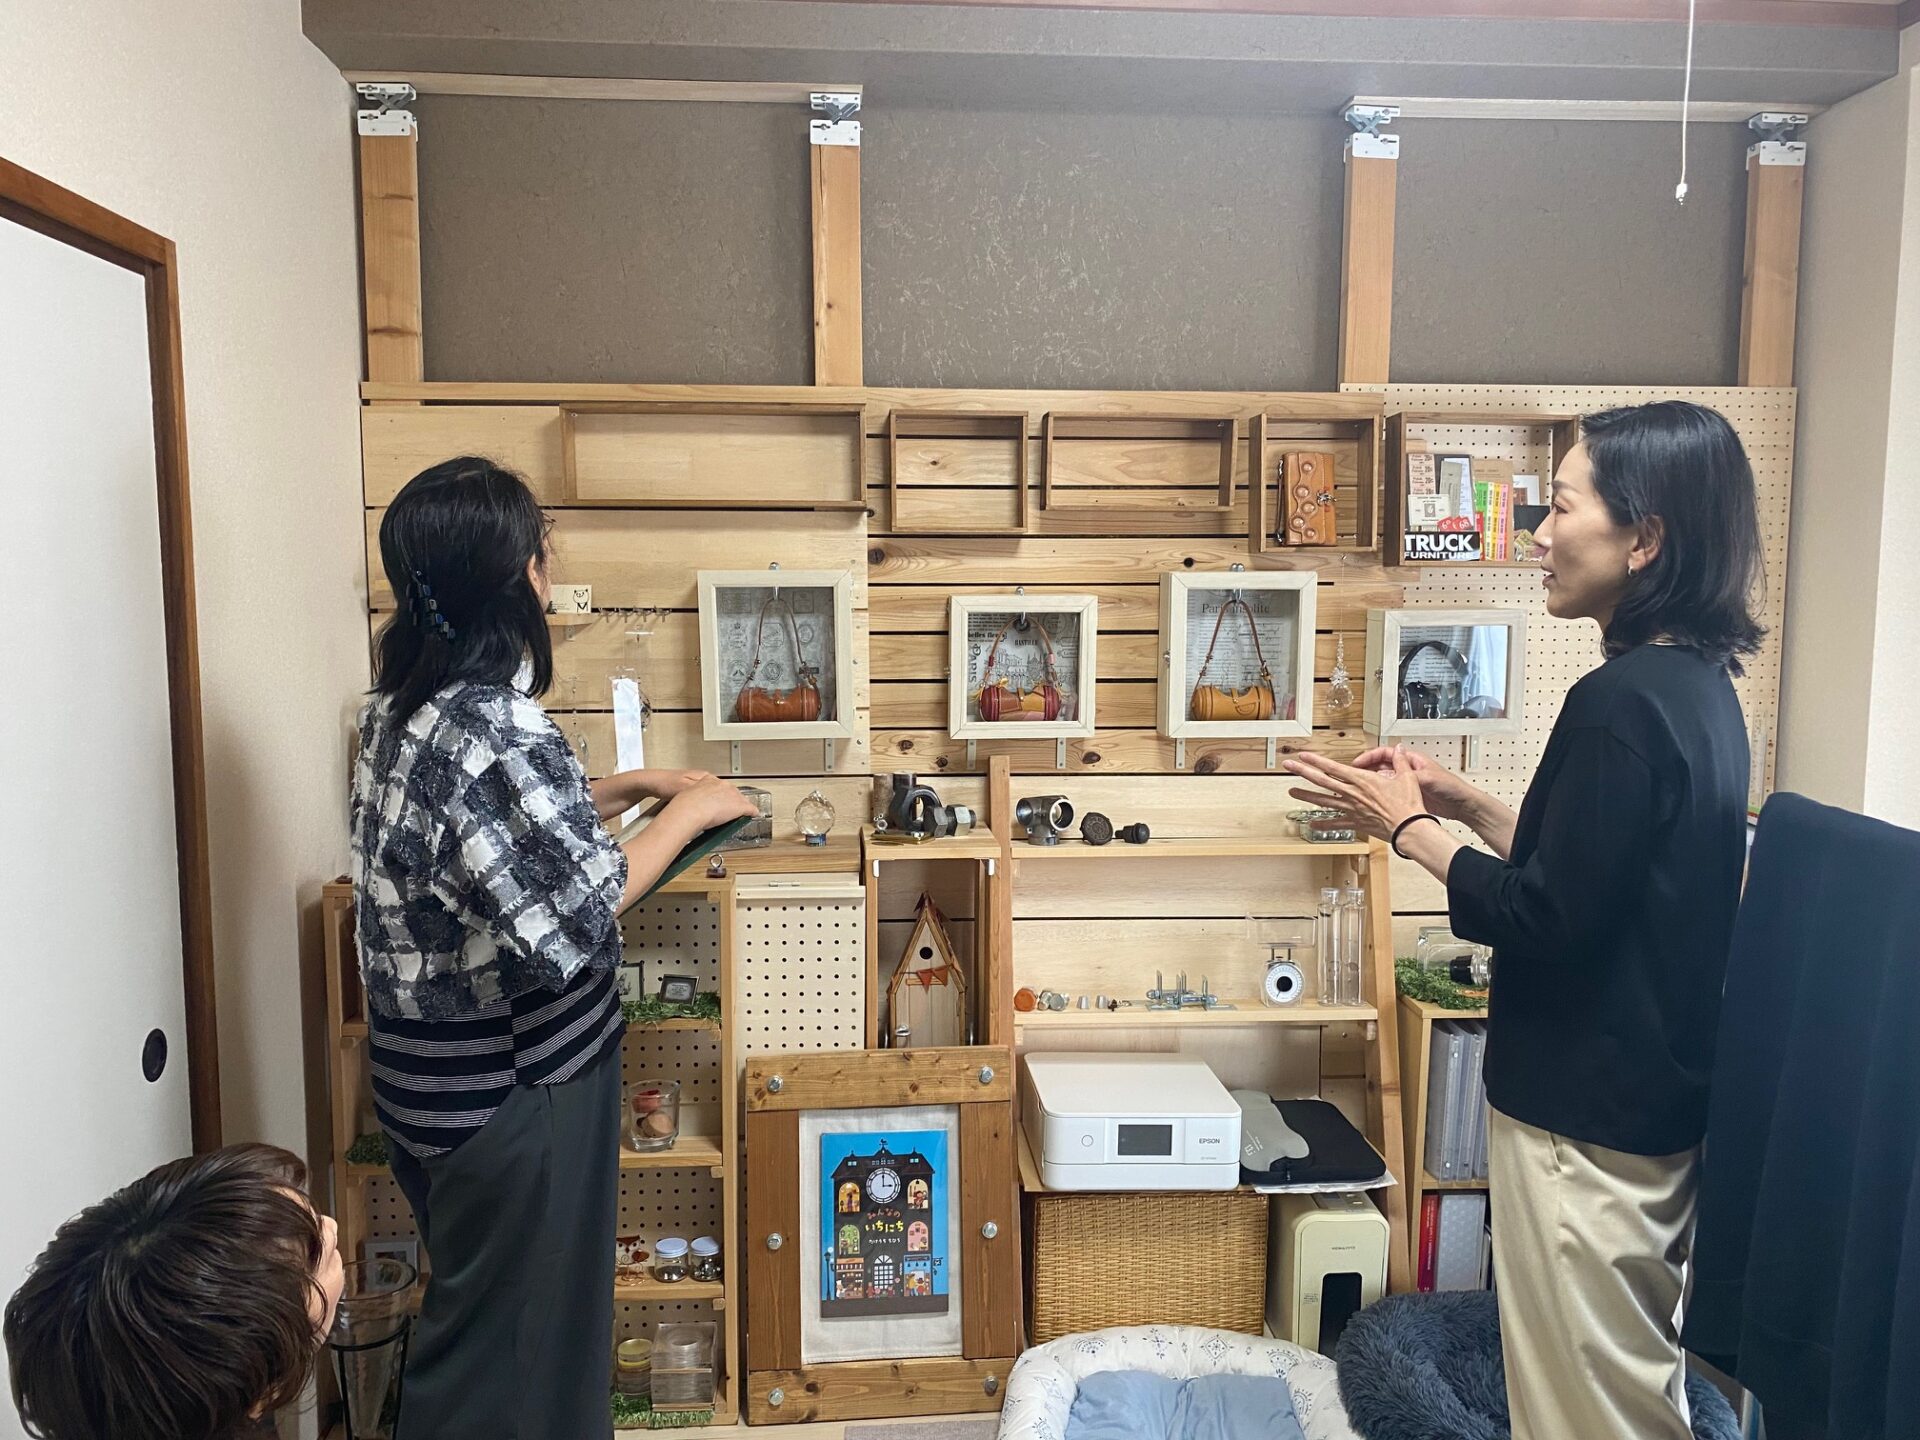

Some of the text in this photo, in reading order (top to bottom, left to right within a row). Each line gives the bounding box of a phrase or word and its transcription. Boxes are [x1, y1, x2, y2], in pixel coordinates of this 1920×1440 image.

[1404, 534, 1473, 552] TRUCK
[865, 1220, 904, 1233] いちにち
